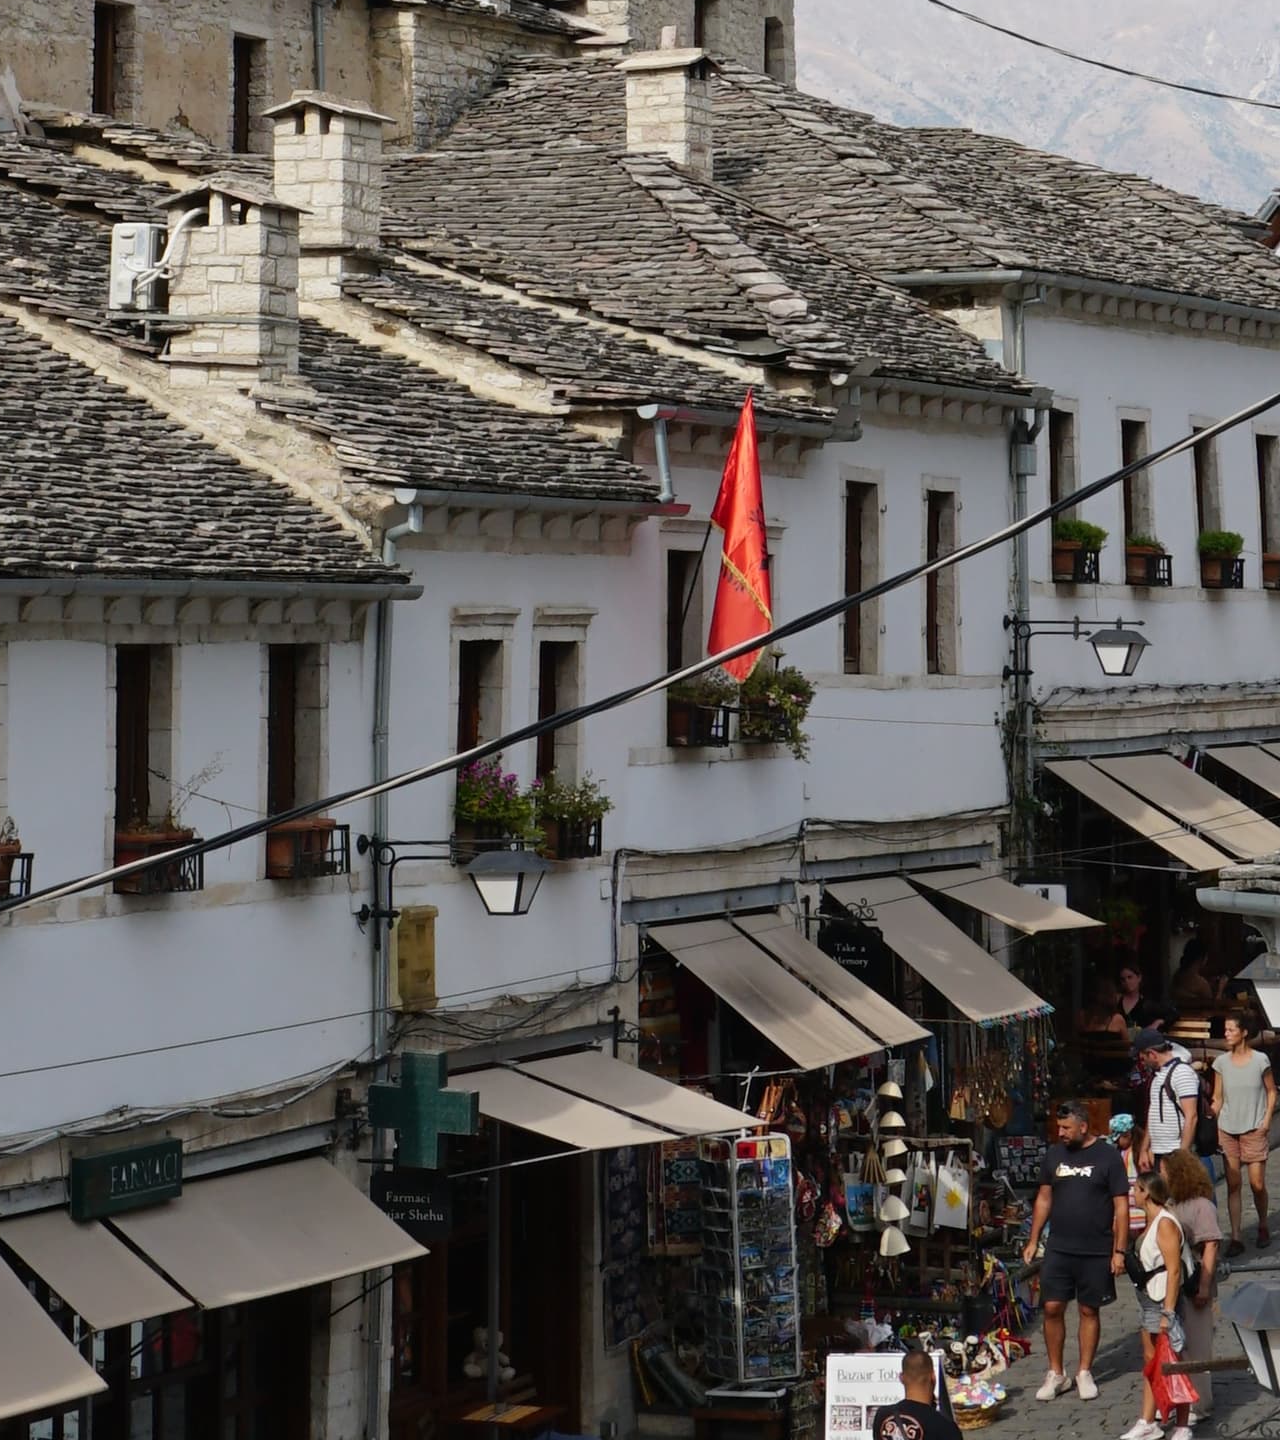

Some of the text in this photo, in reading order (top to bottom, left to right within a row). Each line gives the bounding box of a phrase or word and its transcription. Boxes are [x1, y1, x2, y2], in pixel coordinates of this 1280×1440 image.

[834, 943, 856, 952] Take
[386, 1191, 431, 1204] Farmaci
[409, 1209, 443, 1221] Shehu
